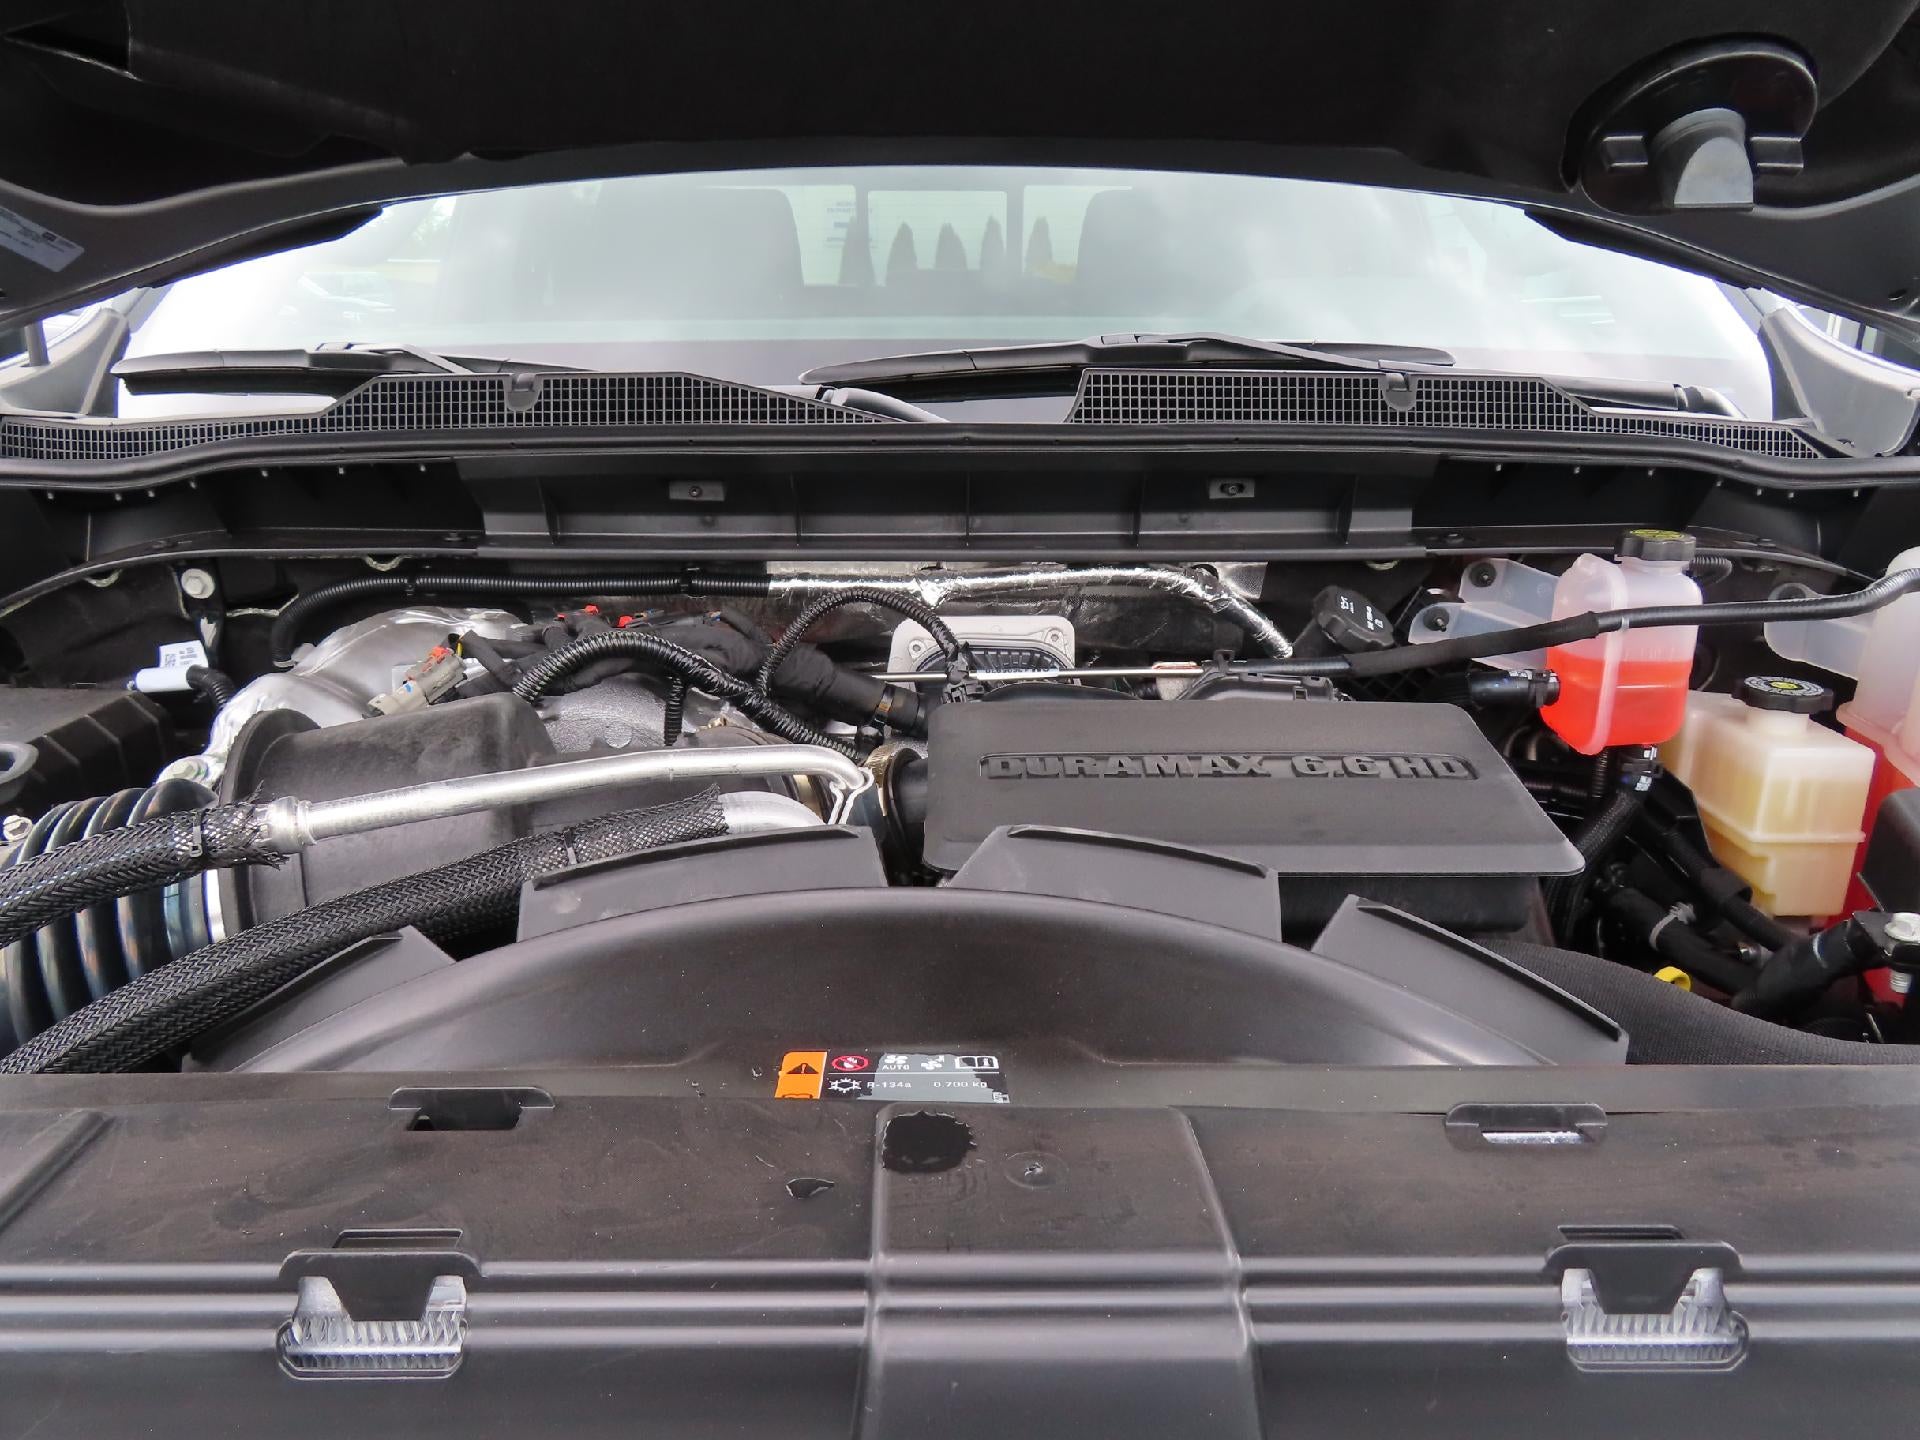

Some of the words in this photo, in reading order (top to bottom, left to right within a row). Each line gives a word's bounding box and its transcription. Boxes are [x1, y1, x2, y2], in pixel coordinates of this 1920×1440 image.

[986, 754, 1272, 779] DURAMAX
[1290, 755, 1381, 778] 6.6
[1390, 756, 1476, 779] HD
[866, 1081, 912, 1089] R-134a
